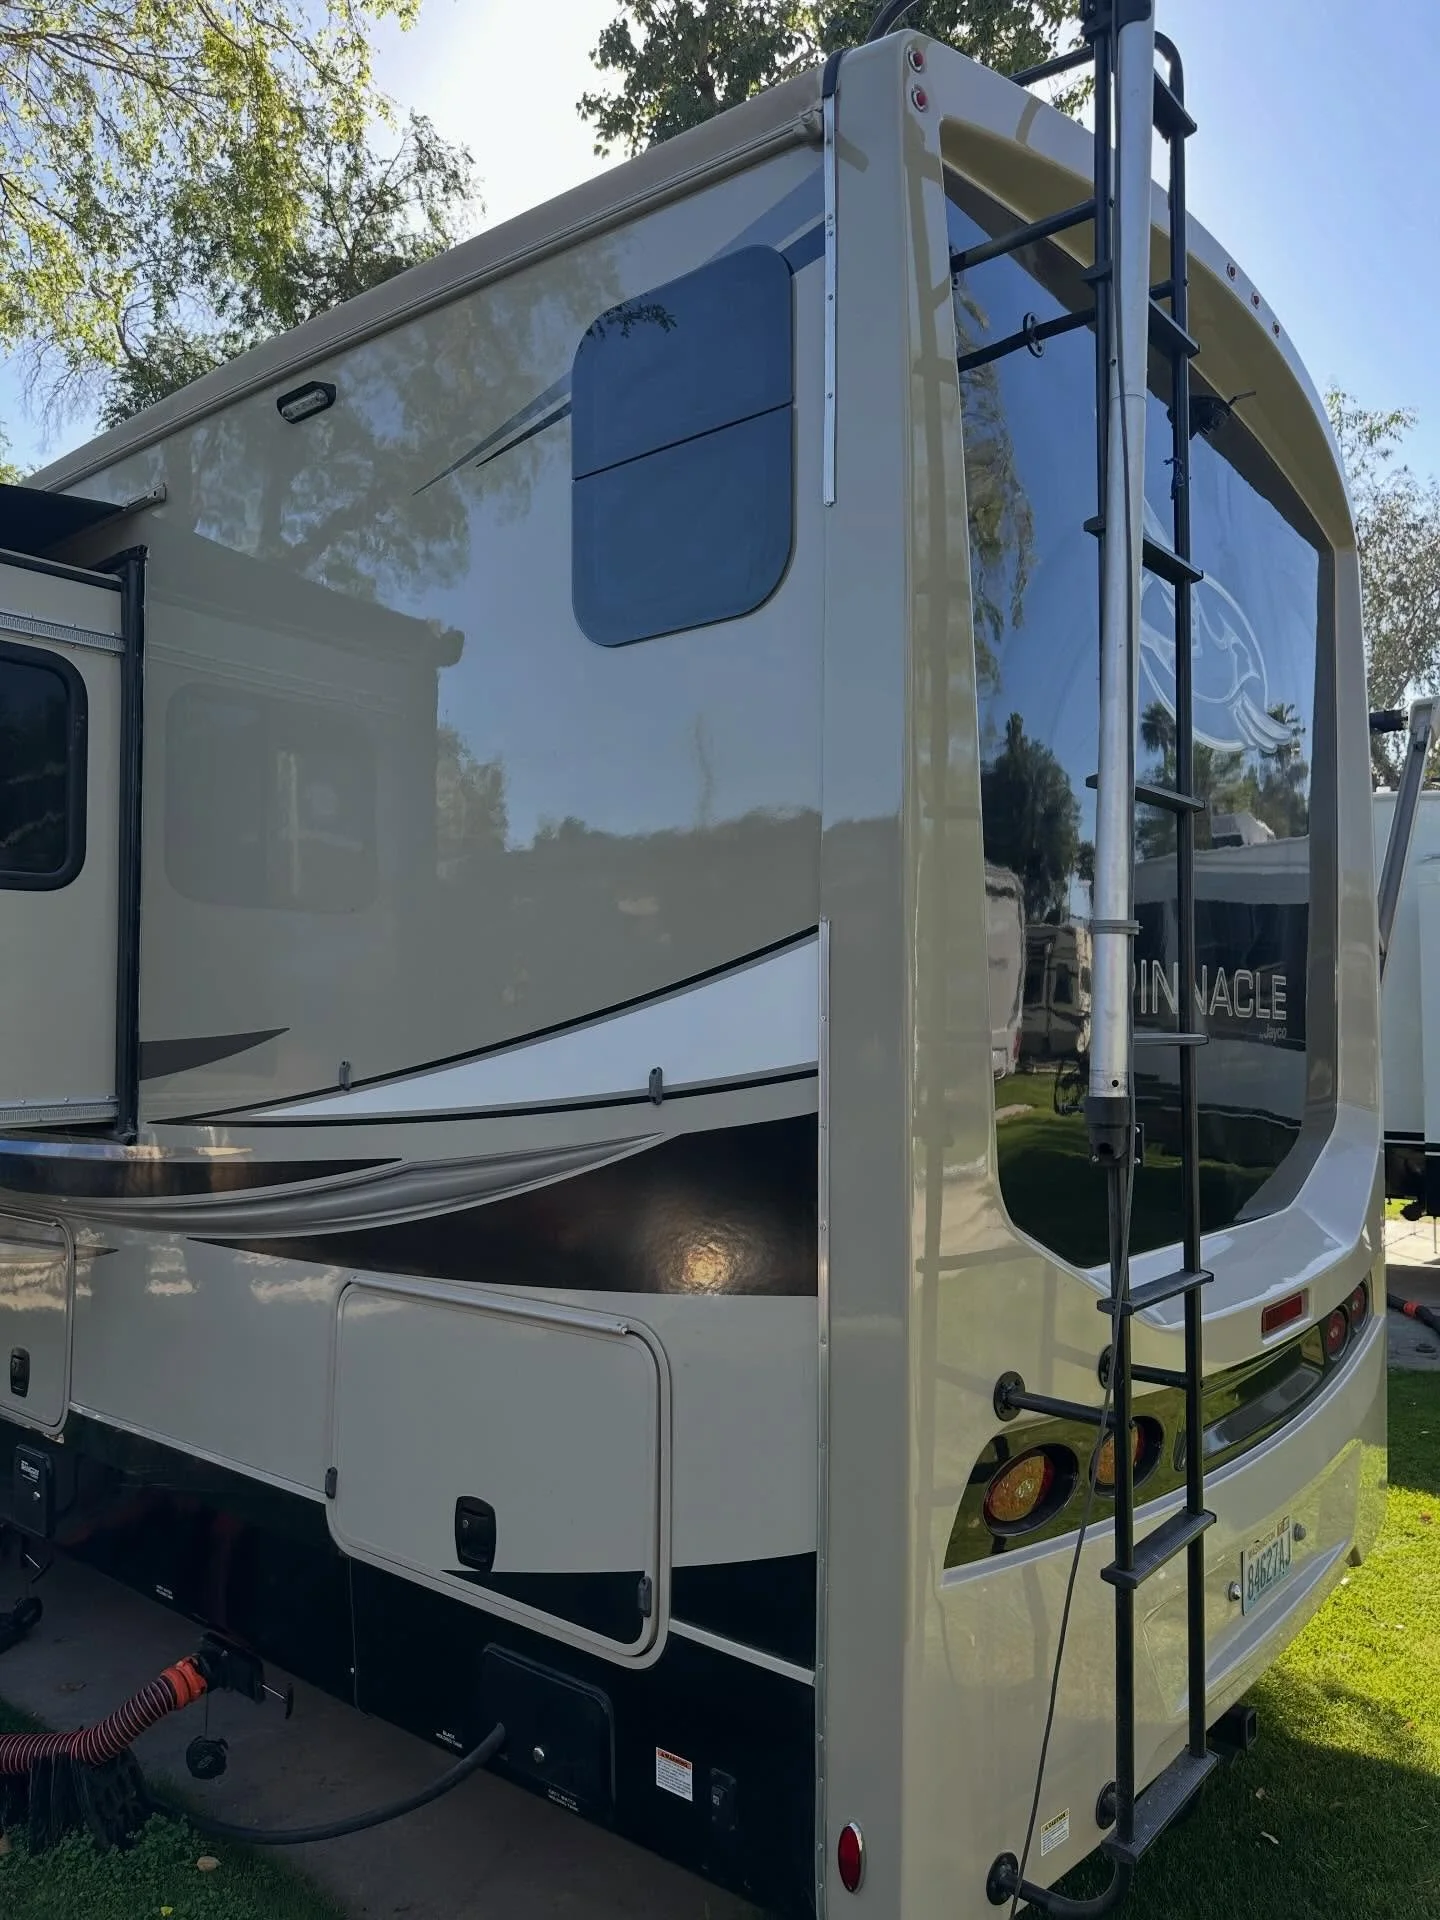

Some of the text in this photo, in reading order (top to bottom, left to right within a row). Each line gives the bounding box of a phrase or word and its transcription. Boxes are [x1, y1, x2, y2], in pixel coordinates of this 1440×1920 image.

[1132, 959, 1286, 1020] INNACLE
[1263, 1023, 1287, 1042] Jayco
[1247, 1531, 1291, 1601] 84627AJ
